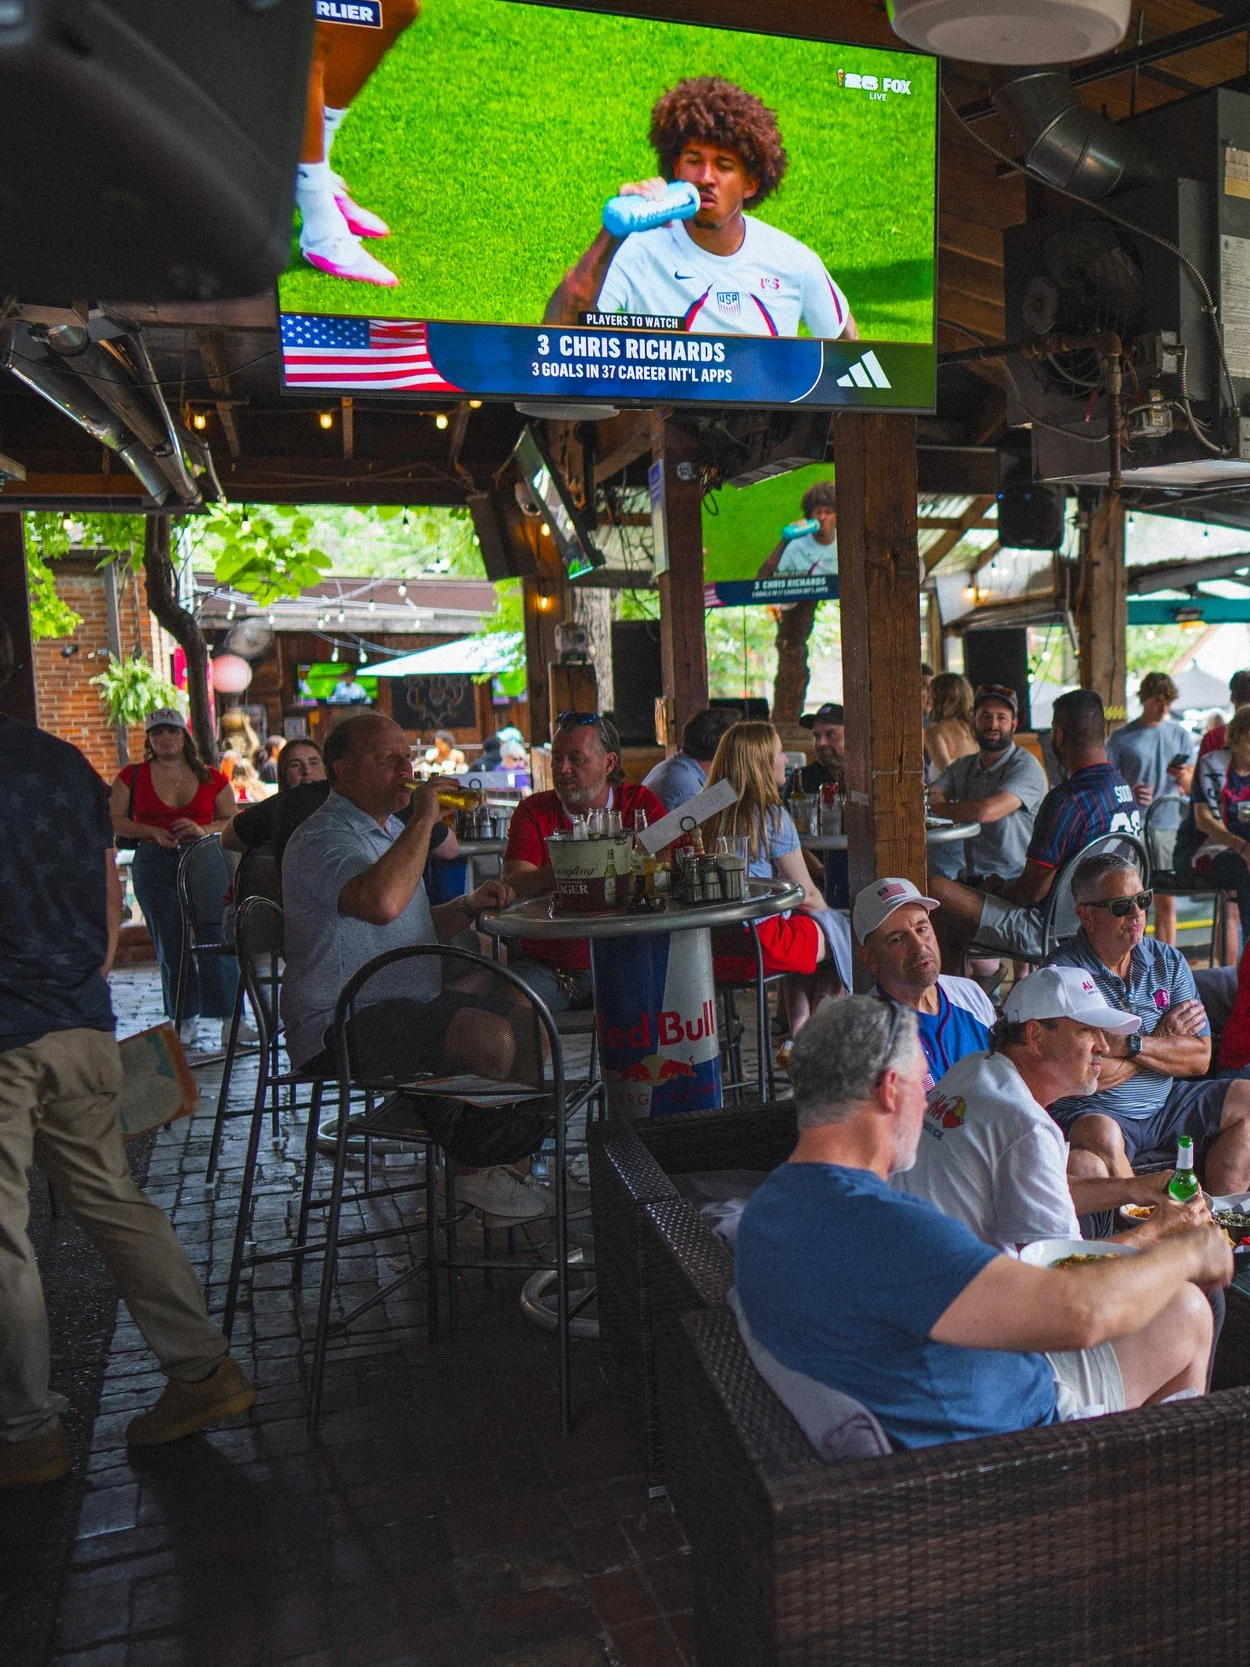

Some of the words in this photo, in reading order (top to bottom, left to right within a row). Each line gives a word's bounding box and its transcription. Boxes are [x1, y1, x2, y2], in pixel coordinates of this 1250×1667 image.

[316, 1, 374, 22] RLIER
[869, 92, 887, 101] LIVE
[883, 77, 912, 95] FOX
[586, 314, 629, 326] PLAYERS
[631, 317, 642, 327] TO
[644, 317, 678, 328] WATCH
[537, 334, 550, 355] 3
[560, 335, 621, 358] CHRIS
[625, 338, 725, 362] RICHARDS
[531, 362, 539, 376] 3
[542, 362, 584, 378] GOALS
[586, 364, 599, 378] IN
[602, 365, 615, 379] 37
[618, 365, 666, 381] CAREER
[668, 367, 698, 382] INT'L
[701, 368, 733, 383] APPS
[657, 999, 715, 1046] Bull
